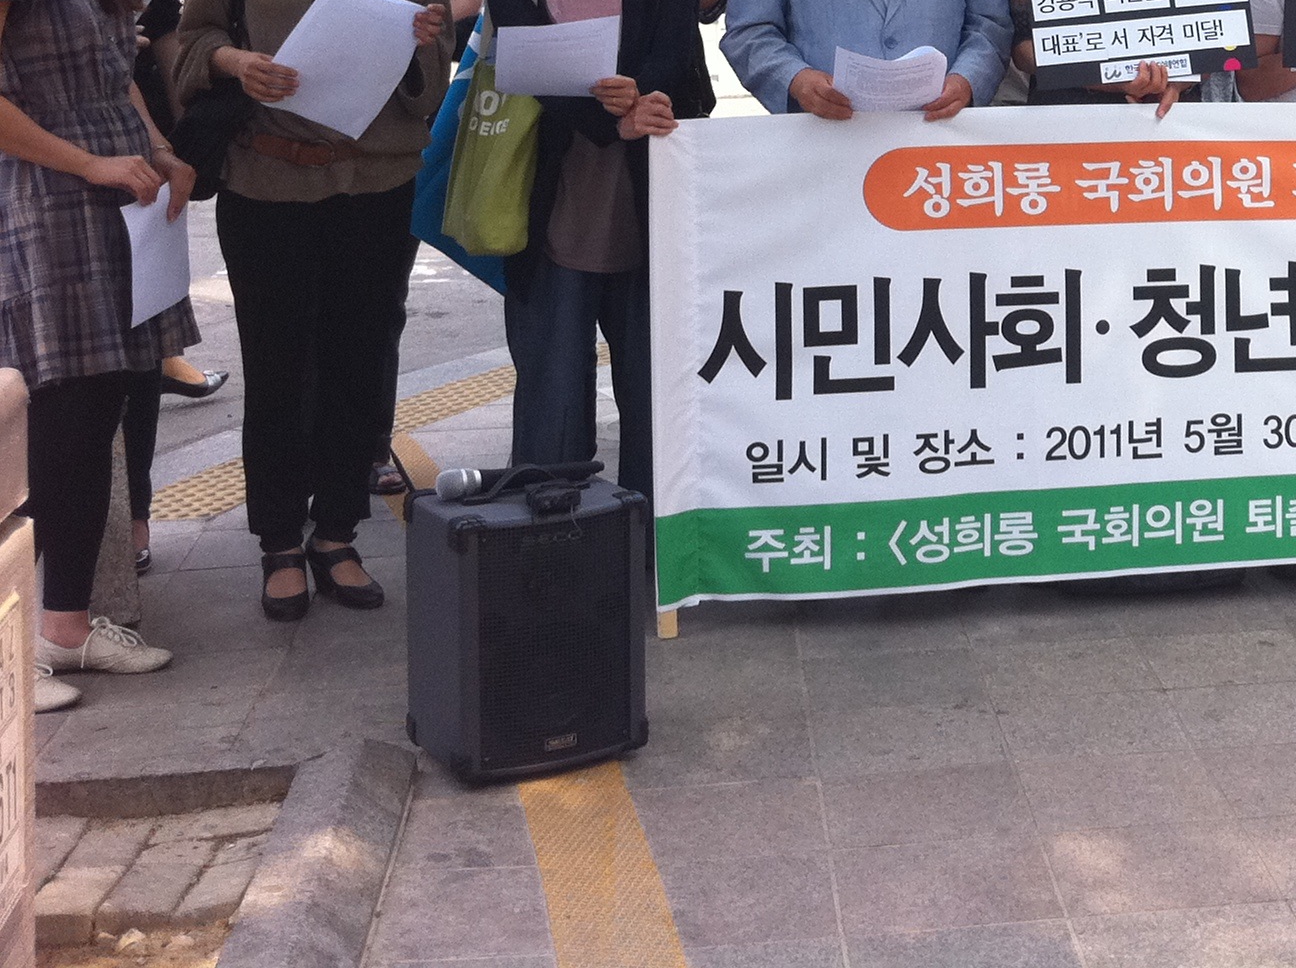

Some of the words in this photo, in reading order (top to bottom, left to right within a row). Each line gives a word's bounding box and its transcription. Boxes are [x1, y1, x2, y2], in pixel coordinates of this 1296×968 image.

[1042, 31, 1105, 56] 대표'로
[1111, 28, 1129, 49] 서
[1138, 24, 1174, 46] 자격
[1183, 19, 1224, 42] 미달!
[903, 160, 1061, 218] 성희롱
[1075, 156, 1274, 212] 국회의원
[745, 438, 828, 483] 일시
[851, 434, 891, 479] 및
[912, 429, 995, 475] 장소
[1045, 418, 1164, 462] 2011년
[1184, 413, 1244, 456] 5월
[743, 525, 833, 573] 주최
[1056, 498, 1226, 551] 국회의원
